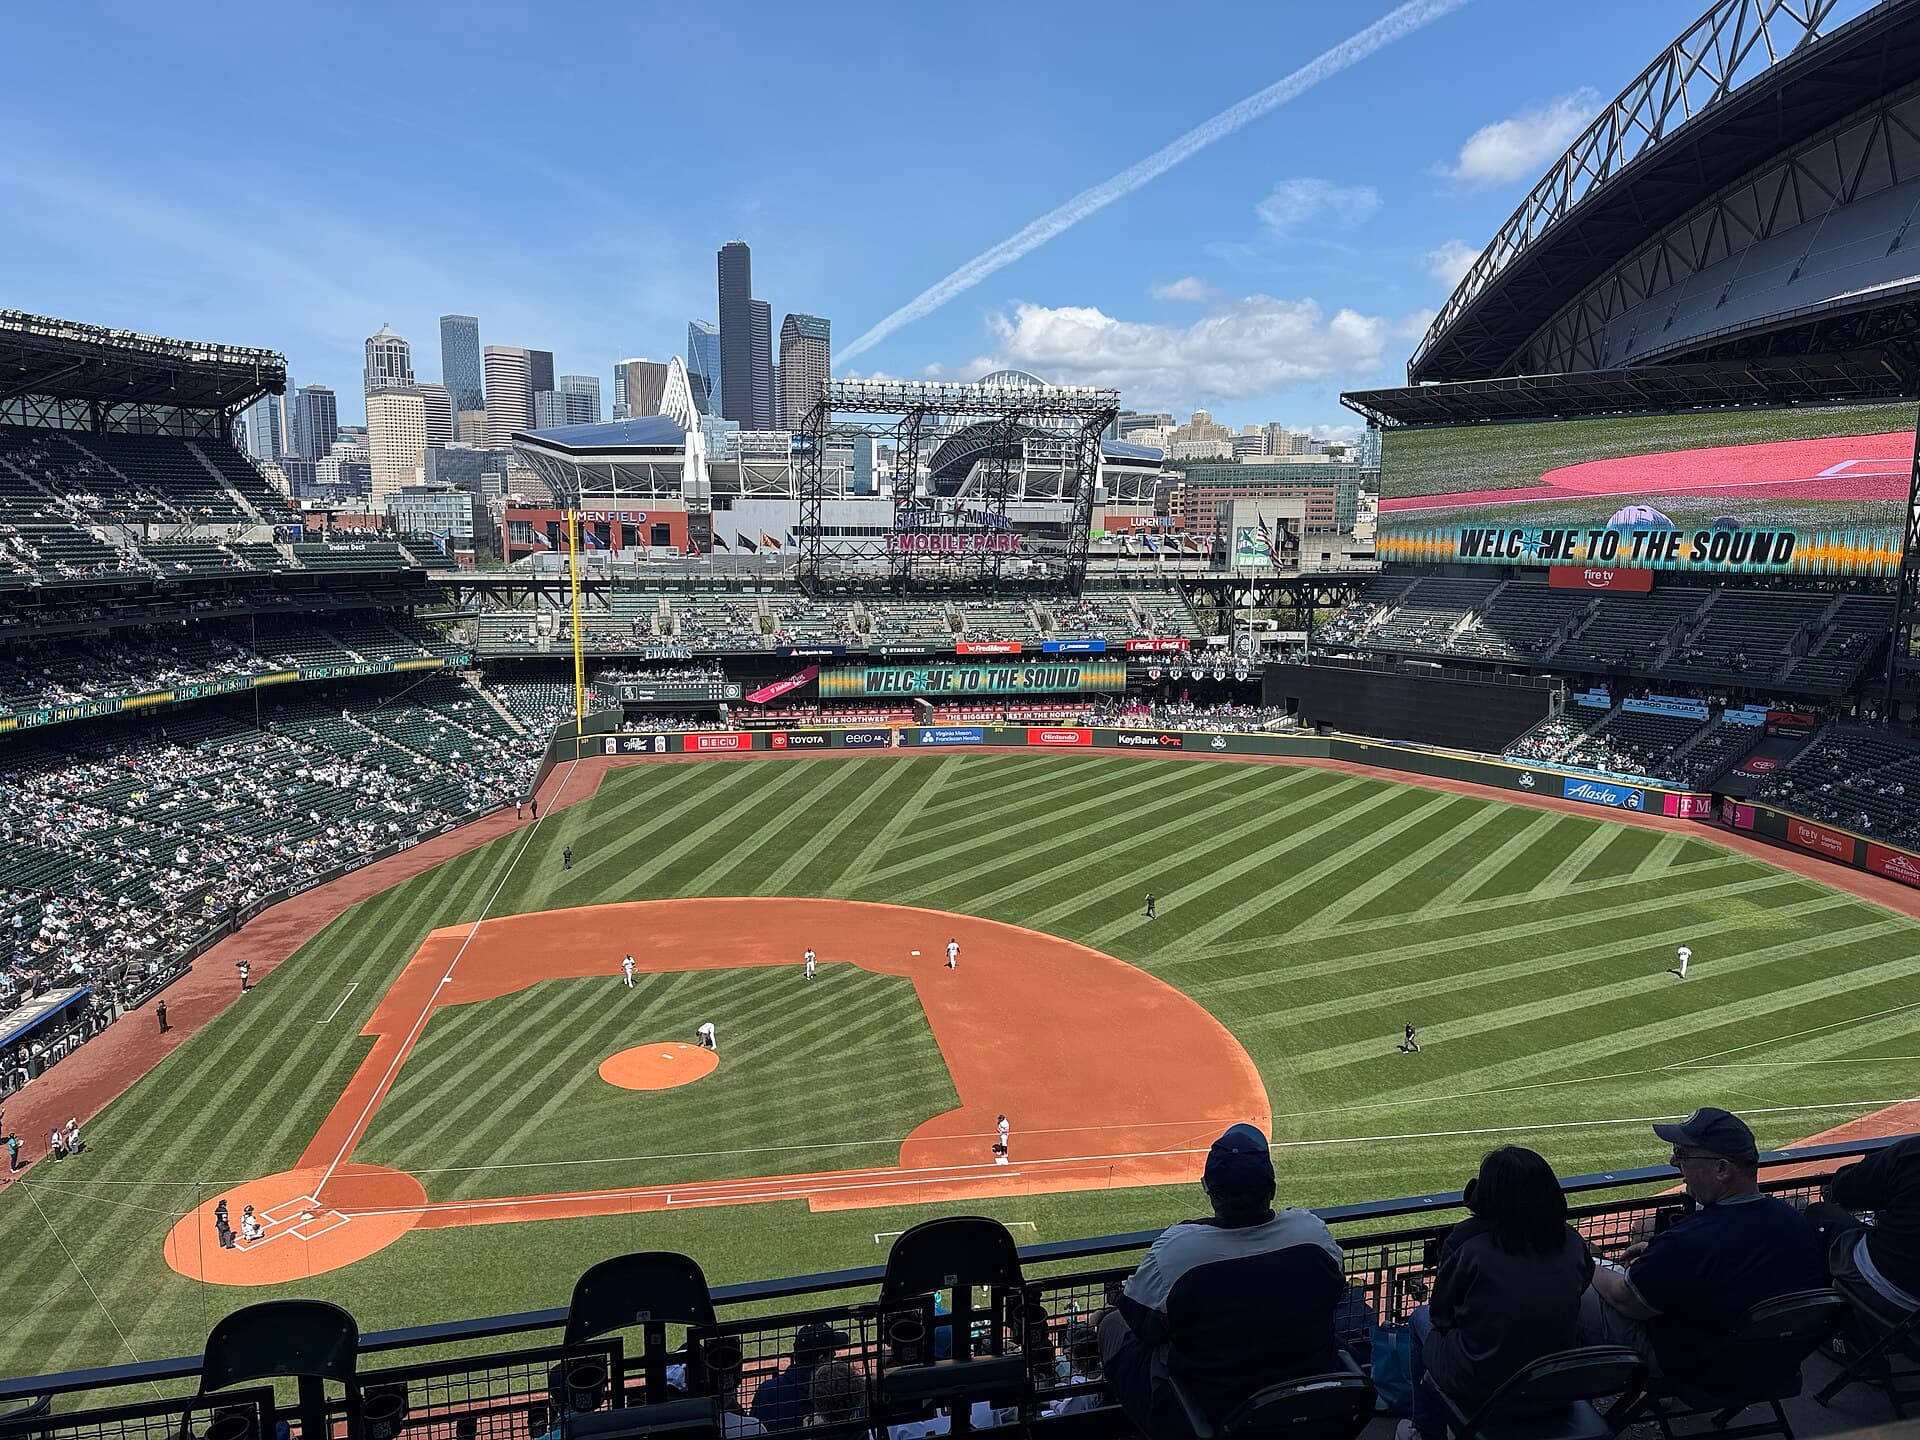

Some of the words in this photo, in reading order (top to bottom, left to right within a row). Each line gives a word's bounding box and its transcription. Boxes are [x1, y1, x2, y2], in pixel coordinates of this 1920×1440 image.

[608, 512, 647, 523] FIELD
[896, 511, 940, 530] SEATTLE
[966, 508, 1013, 530] MARINERS
[1131, 517, 1159, 527] LUMEN
[882, 534, 970, 551] T-MOBILE
[973, 534, 1022, 551] PARK
[1460, 528, 1576, 560] WELCME
[1586, 530, 1621, 561] TO
[1631, 530, 1681, 563] THE
[1690, 530, 1797, 566] SOUND
[1584, 569, 1601, 579] fire
[1602, 571, 1613, 581] tv
[645, 648, 692, 659] EDGARS
[300, 666, 338, 681] WELCME
[340, 665, 350, 677] TO
[354, 663, 368, 676] THE
[370, 661, 395, 674] SOUND
[866, 669, 952, 692] WELCME
[958, 669, 980, 690] TO
[988, 668, 1019, 689] THE
[1024, 667, 1081, 688] SOUND
[174, 685, 208, 701] WELCME
[233, 676, 255, 691] SOUND
[16, 709, 60, 729] WELCME
[64, 707, 75, 720] TO
[79, 704, 93, 719] THE
[96, 699, 122, 715] SOUND
[840, 715, 889, 723] NORTHWEST
[963, 713, 994, 721] BIGGEST
[701, 738, 736, 746] BECU
[790, 736, 824, 744] TOYOTA
[845, 734, 871, 743] eero
[1044, 733, 1076, 741] Nintendo
[1118, 734, 1159, 747] KeyBank
[1732, 769, 1770, 779] TOYOT
[1568, 783, 1617, 803] Alaska
[1798, 825, 1810, 837] fire
[398, 836, 420, 851] STIHL
[344, 861, 360, 872] Great
[296, 878, 320, 892] LEXUS
